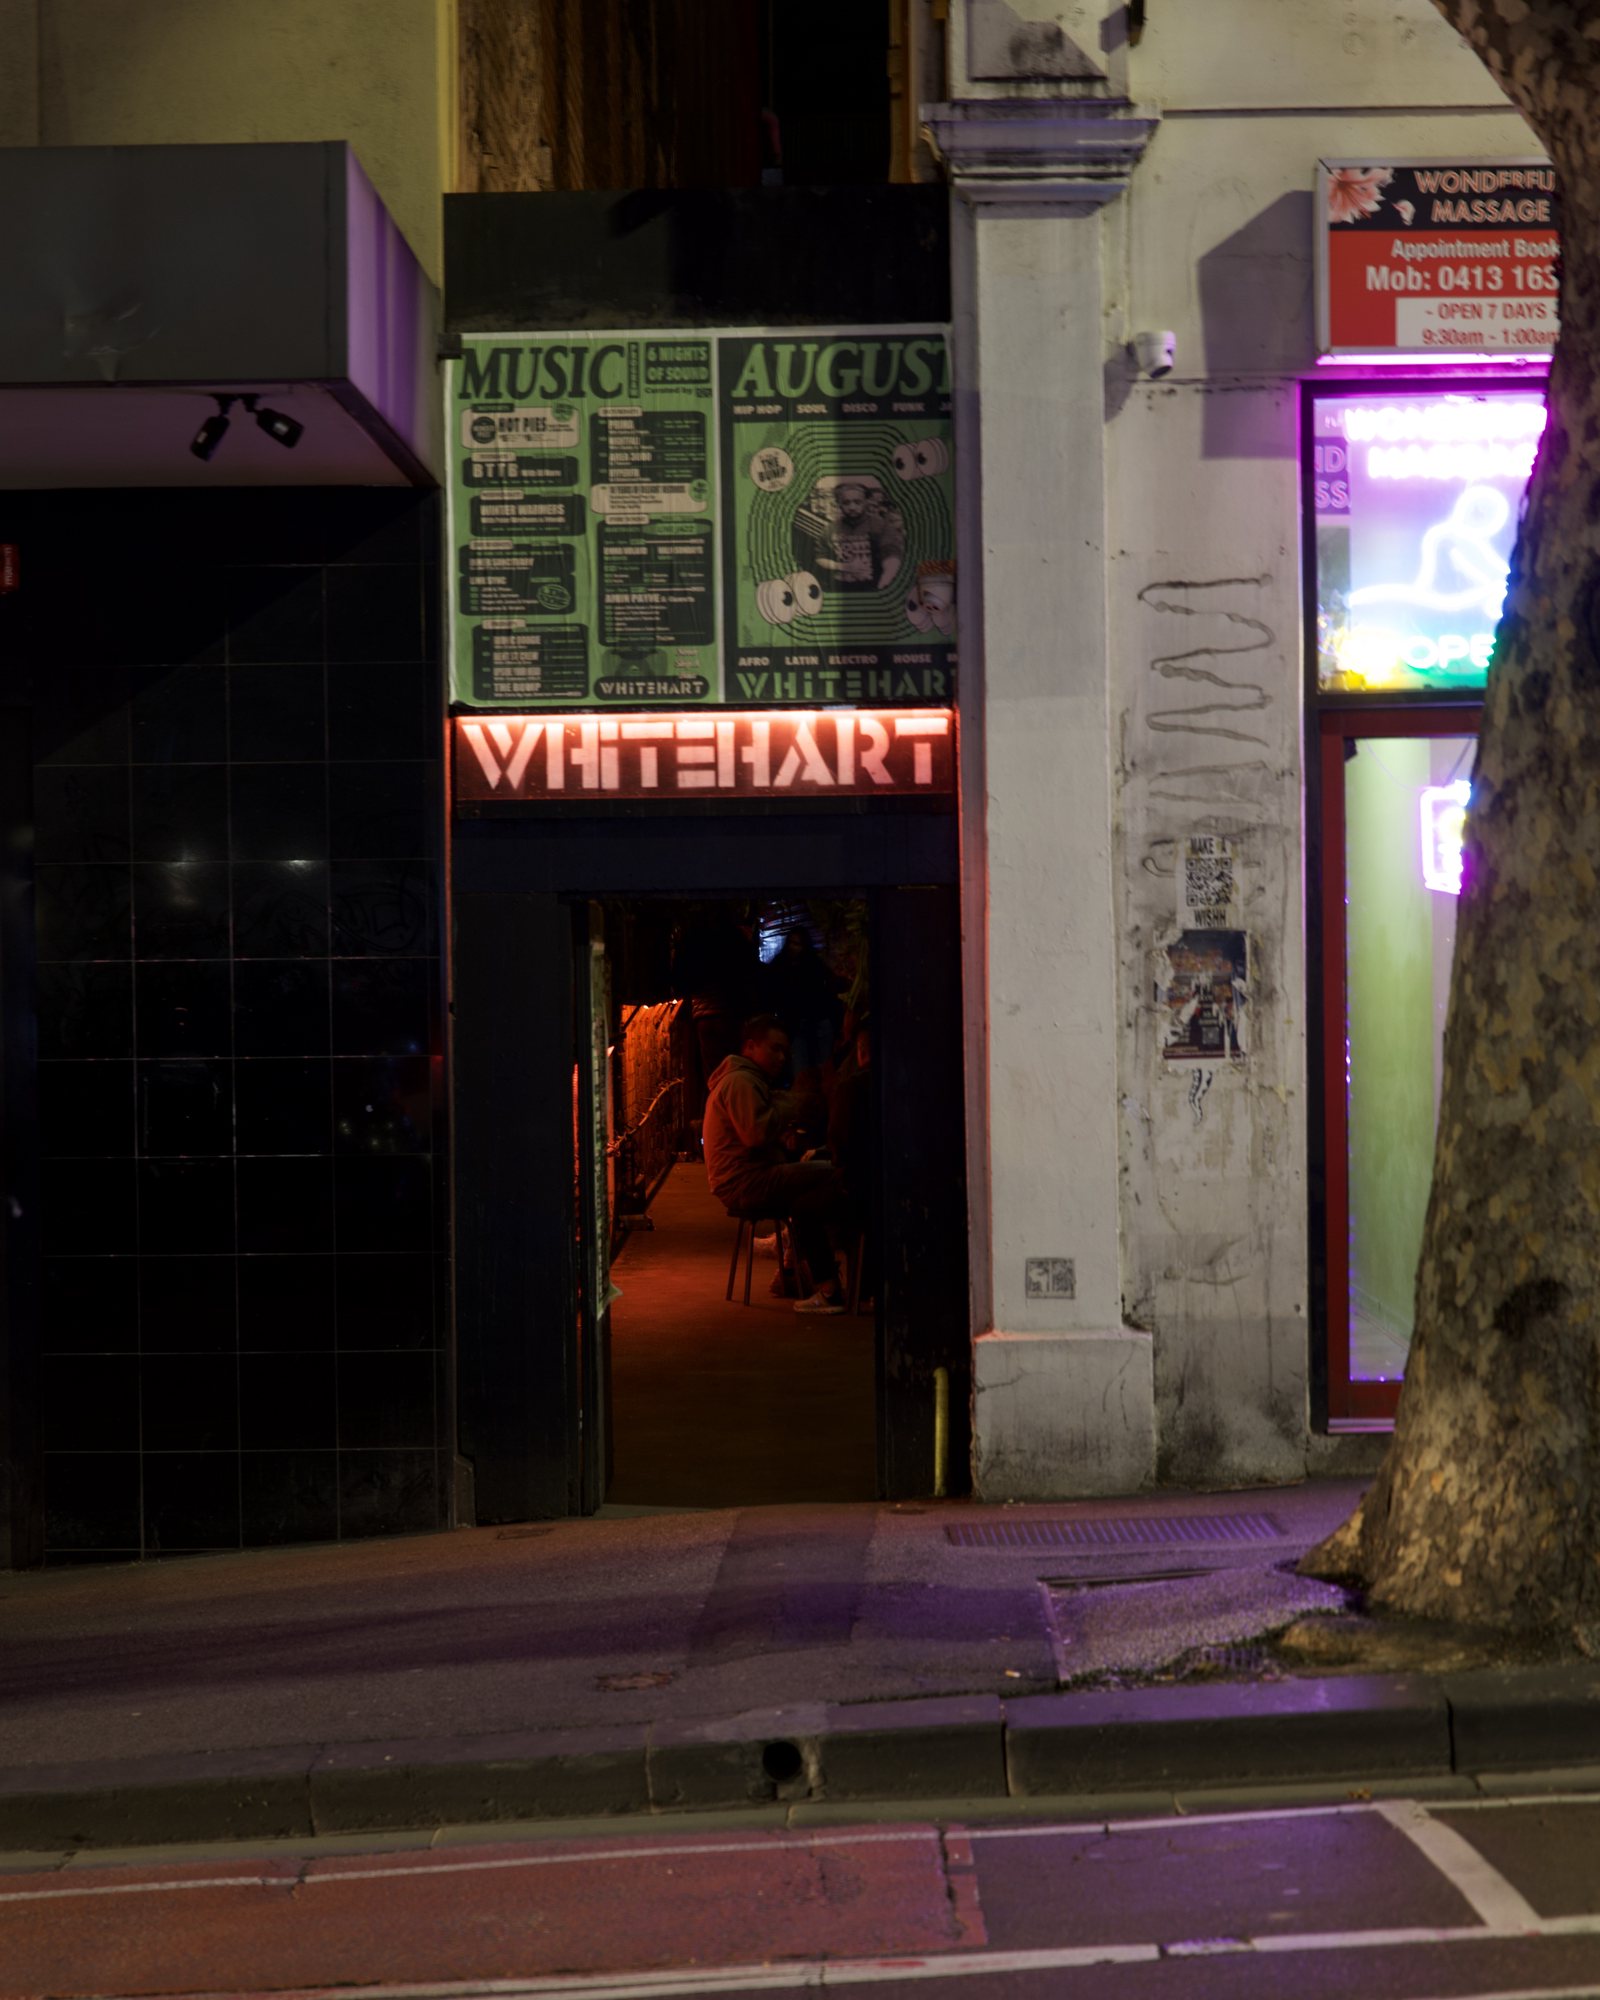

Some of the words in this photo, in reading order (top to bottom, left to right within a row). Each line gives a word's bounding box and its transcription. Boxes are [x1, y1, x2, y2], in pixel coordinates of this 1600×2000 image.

[1413, 169, 1555, 194] WONDERFU
[1430, 198, 1550, 222] MASSAGE
[1391, 238, 1510, 262] Appointment
[1514, 238, 1560, 258] Book
[1366, 265, 1430, 291] Mob:
[1438, 265, 1503, 290] 0413
[1438, 303, 1482, 319] OPEN
[1487, 303, 1497, 319] 7
[1502, 302, 1547, 319] DAYS
[1422, 328, 1484, 345] 9:30am
[458, 344, 625, 400] MUSIC
[648, 367, 665, 380] OF
[665, 367, 709, 380] SOUND
[796, 404, 828, 414] SOUL
[841, 403, 878, 413] DISCO
[738, 657, 770, 667] AFRO
[784, 656, 819, 666] LATIN
[828, 655, 878, 665] ELECTRO
[893, 653, 932, 664] HOUSE
[1396, 633, 1496, 669] OPE
[736, 669, 956, 699] WHITEHAR
[462, 717, 948, 790] WHITEHART
